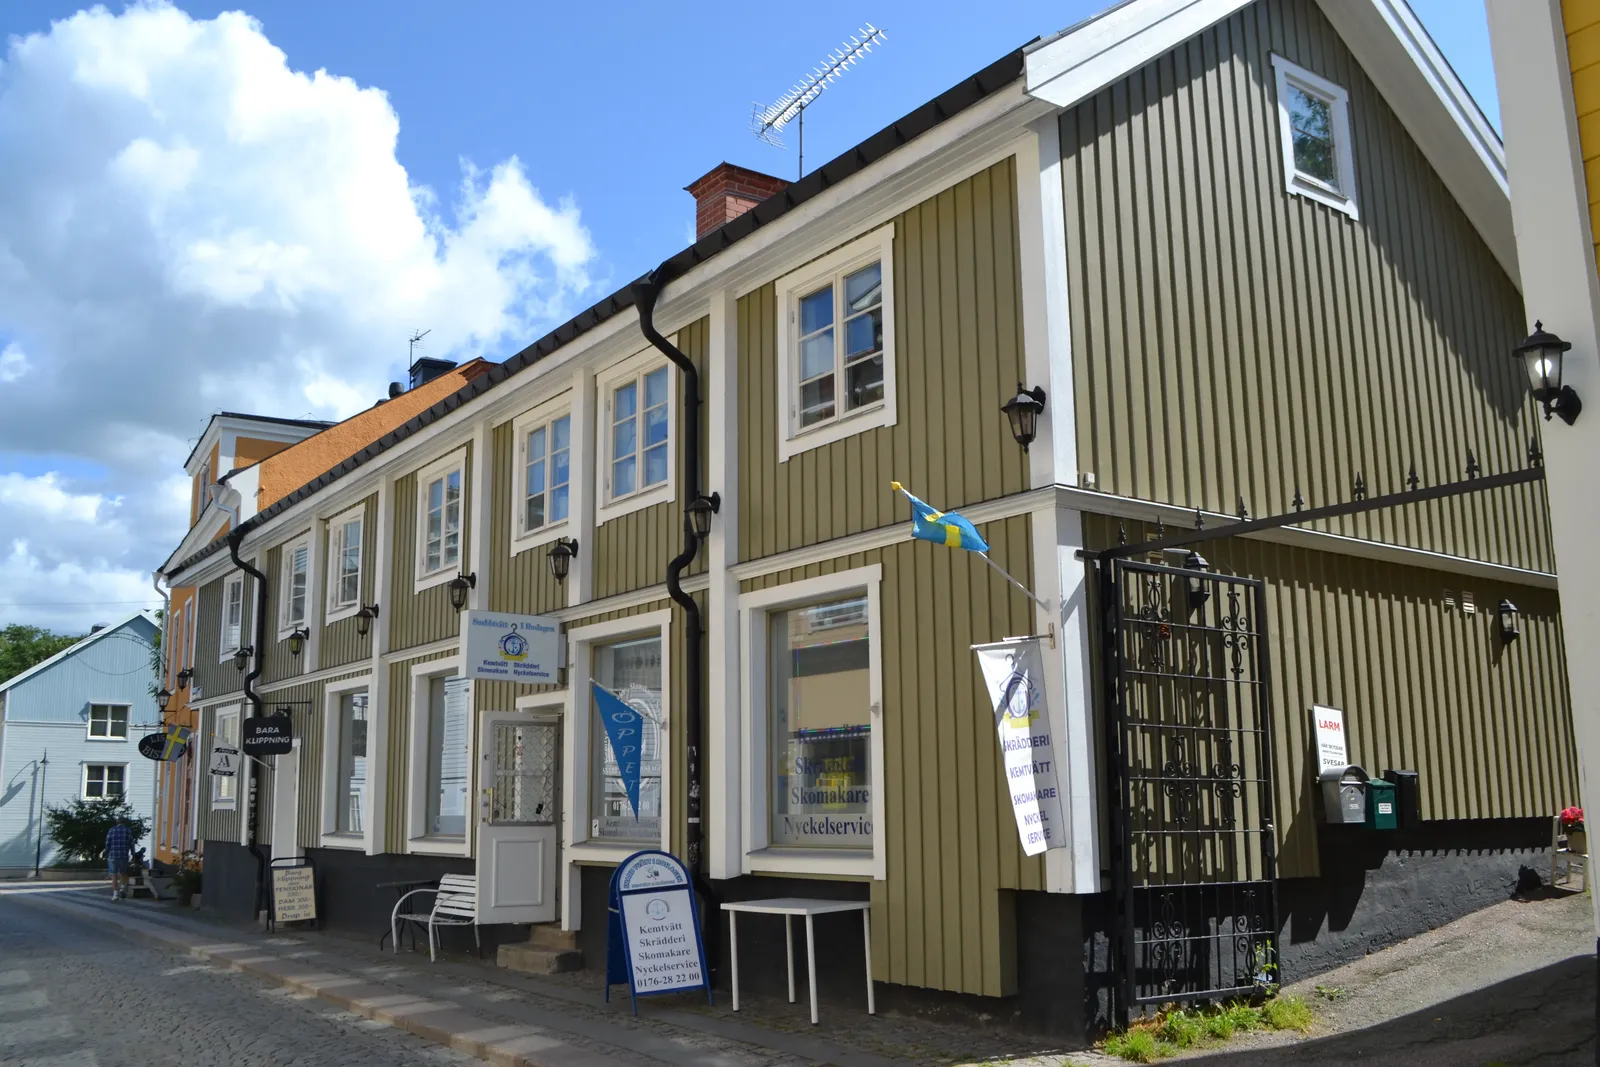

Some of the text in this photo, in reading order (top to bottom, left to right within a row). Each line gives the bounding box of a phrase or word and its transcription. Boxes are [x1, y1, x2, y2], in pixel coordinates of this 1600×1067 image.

[483, 659, 508, 667] Kemtvätt
[513, 669, 549, 678] Nyckelservice
[255, 726, 280, 734] BARA
[1318, 719, 1341, 732] LARM
[245, 736, 290, 745] KLIPPNING
[1003, 734, 1050, 752] SKRÄDDERI
[1009, 761, 1051, 779] KEMTVÄTT
[791, 786, 870, 805] Skomakare
[1013, 787, 1057, 806] SKOMAKARE
[1024, 810, 1049, 826] NYCKEL
[1027, 827, 1051, 845] SERVICE
[281, 912, 301, 920] Drop
[639, 922, 682, 935] Kemtvätt
[639, 934, 686, 948] Skrädderi
[638, 948, 691, 961] Skomakare
[635, 960, 698, 976] Nyckelservice
[637, 972, 700, 988] 0176-28 22 00
